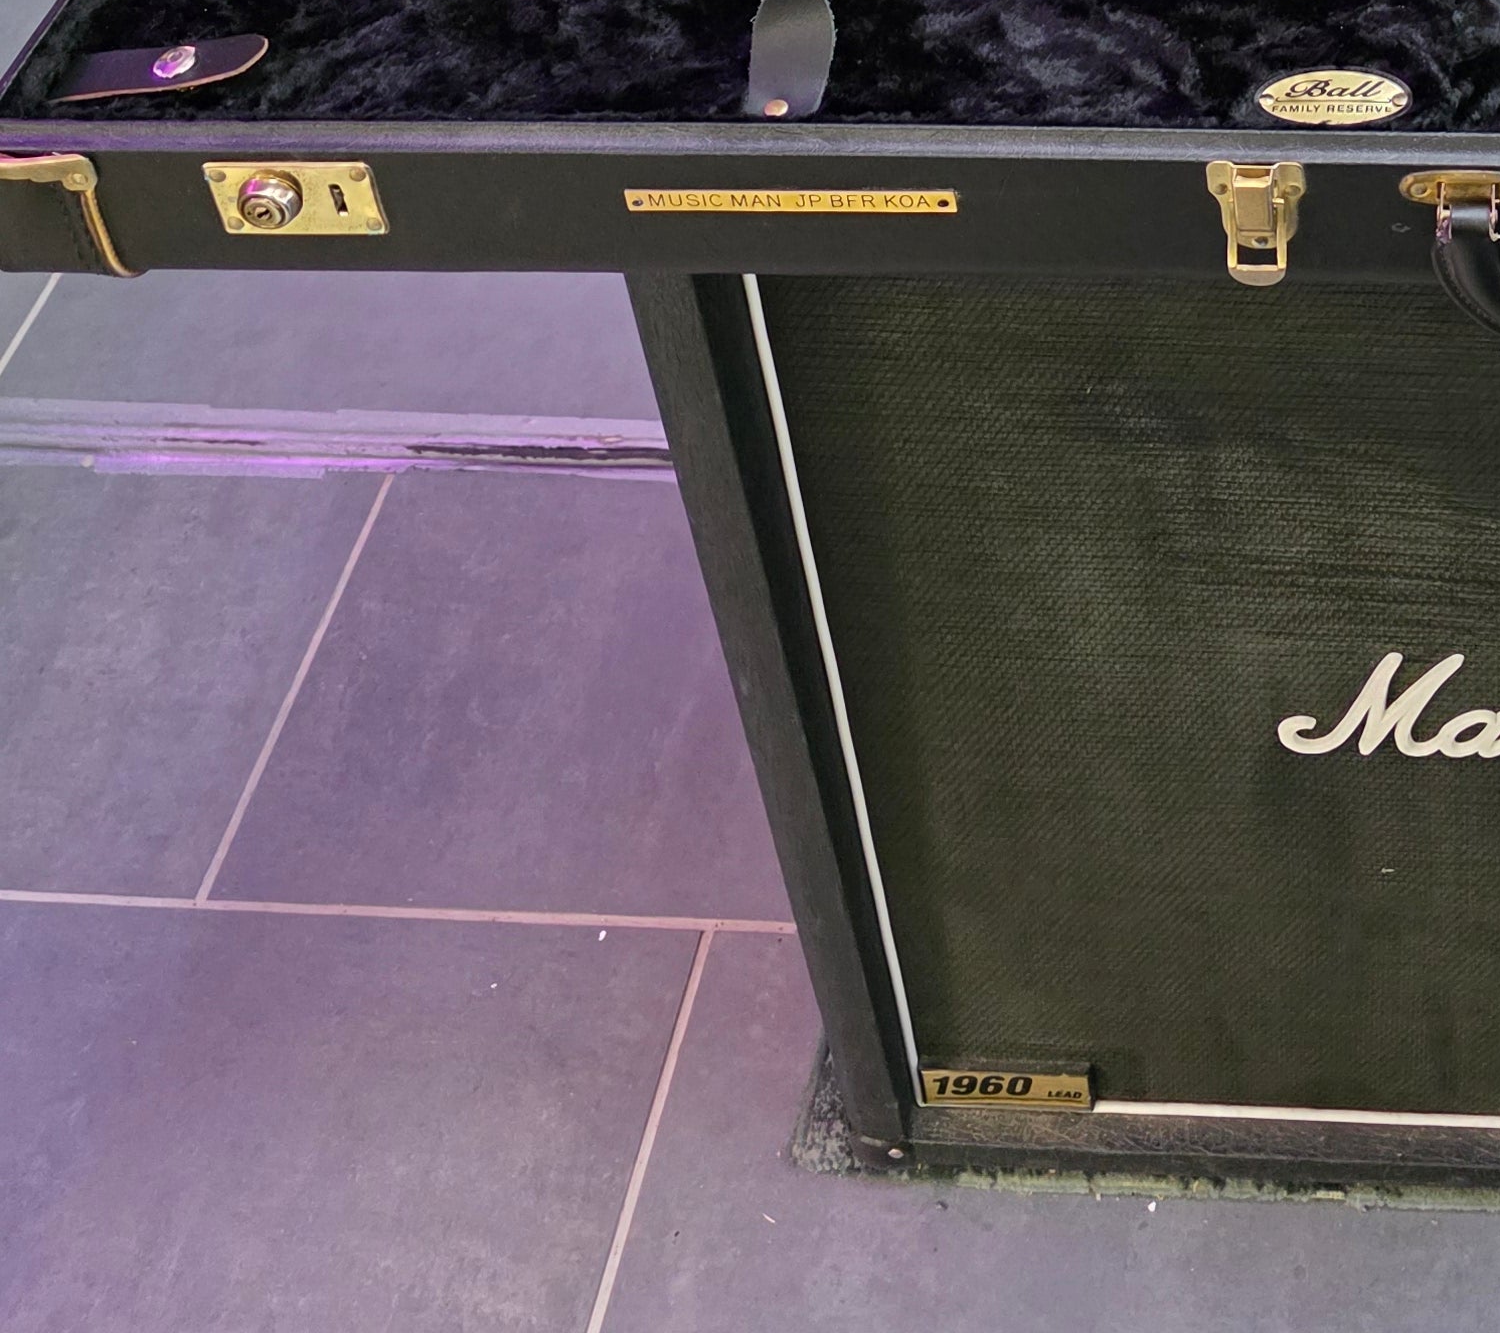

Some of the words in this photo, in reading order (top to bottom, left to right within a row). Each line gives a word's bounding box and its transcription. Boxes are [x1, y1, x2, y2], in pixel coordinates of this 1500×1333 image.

[1285, 79, 1385, 98] Ball
[1272, 104, 1321, 113] FAMILY
[1326, 104, 1392, 113] RESERVE
[648, 193, 723, 207] MUSIC
[730, 194, 782, 207] MAN
[795, 194, 822, 208] JP
[829, 194, 876, 208] BFR
[883, 194, 931, 208] KOA
[933, 1075, 1033, 1096] 1960
[1047, 1090, 1082, 1099] LEAD
